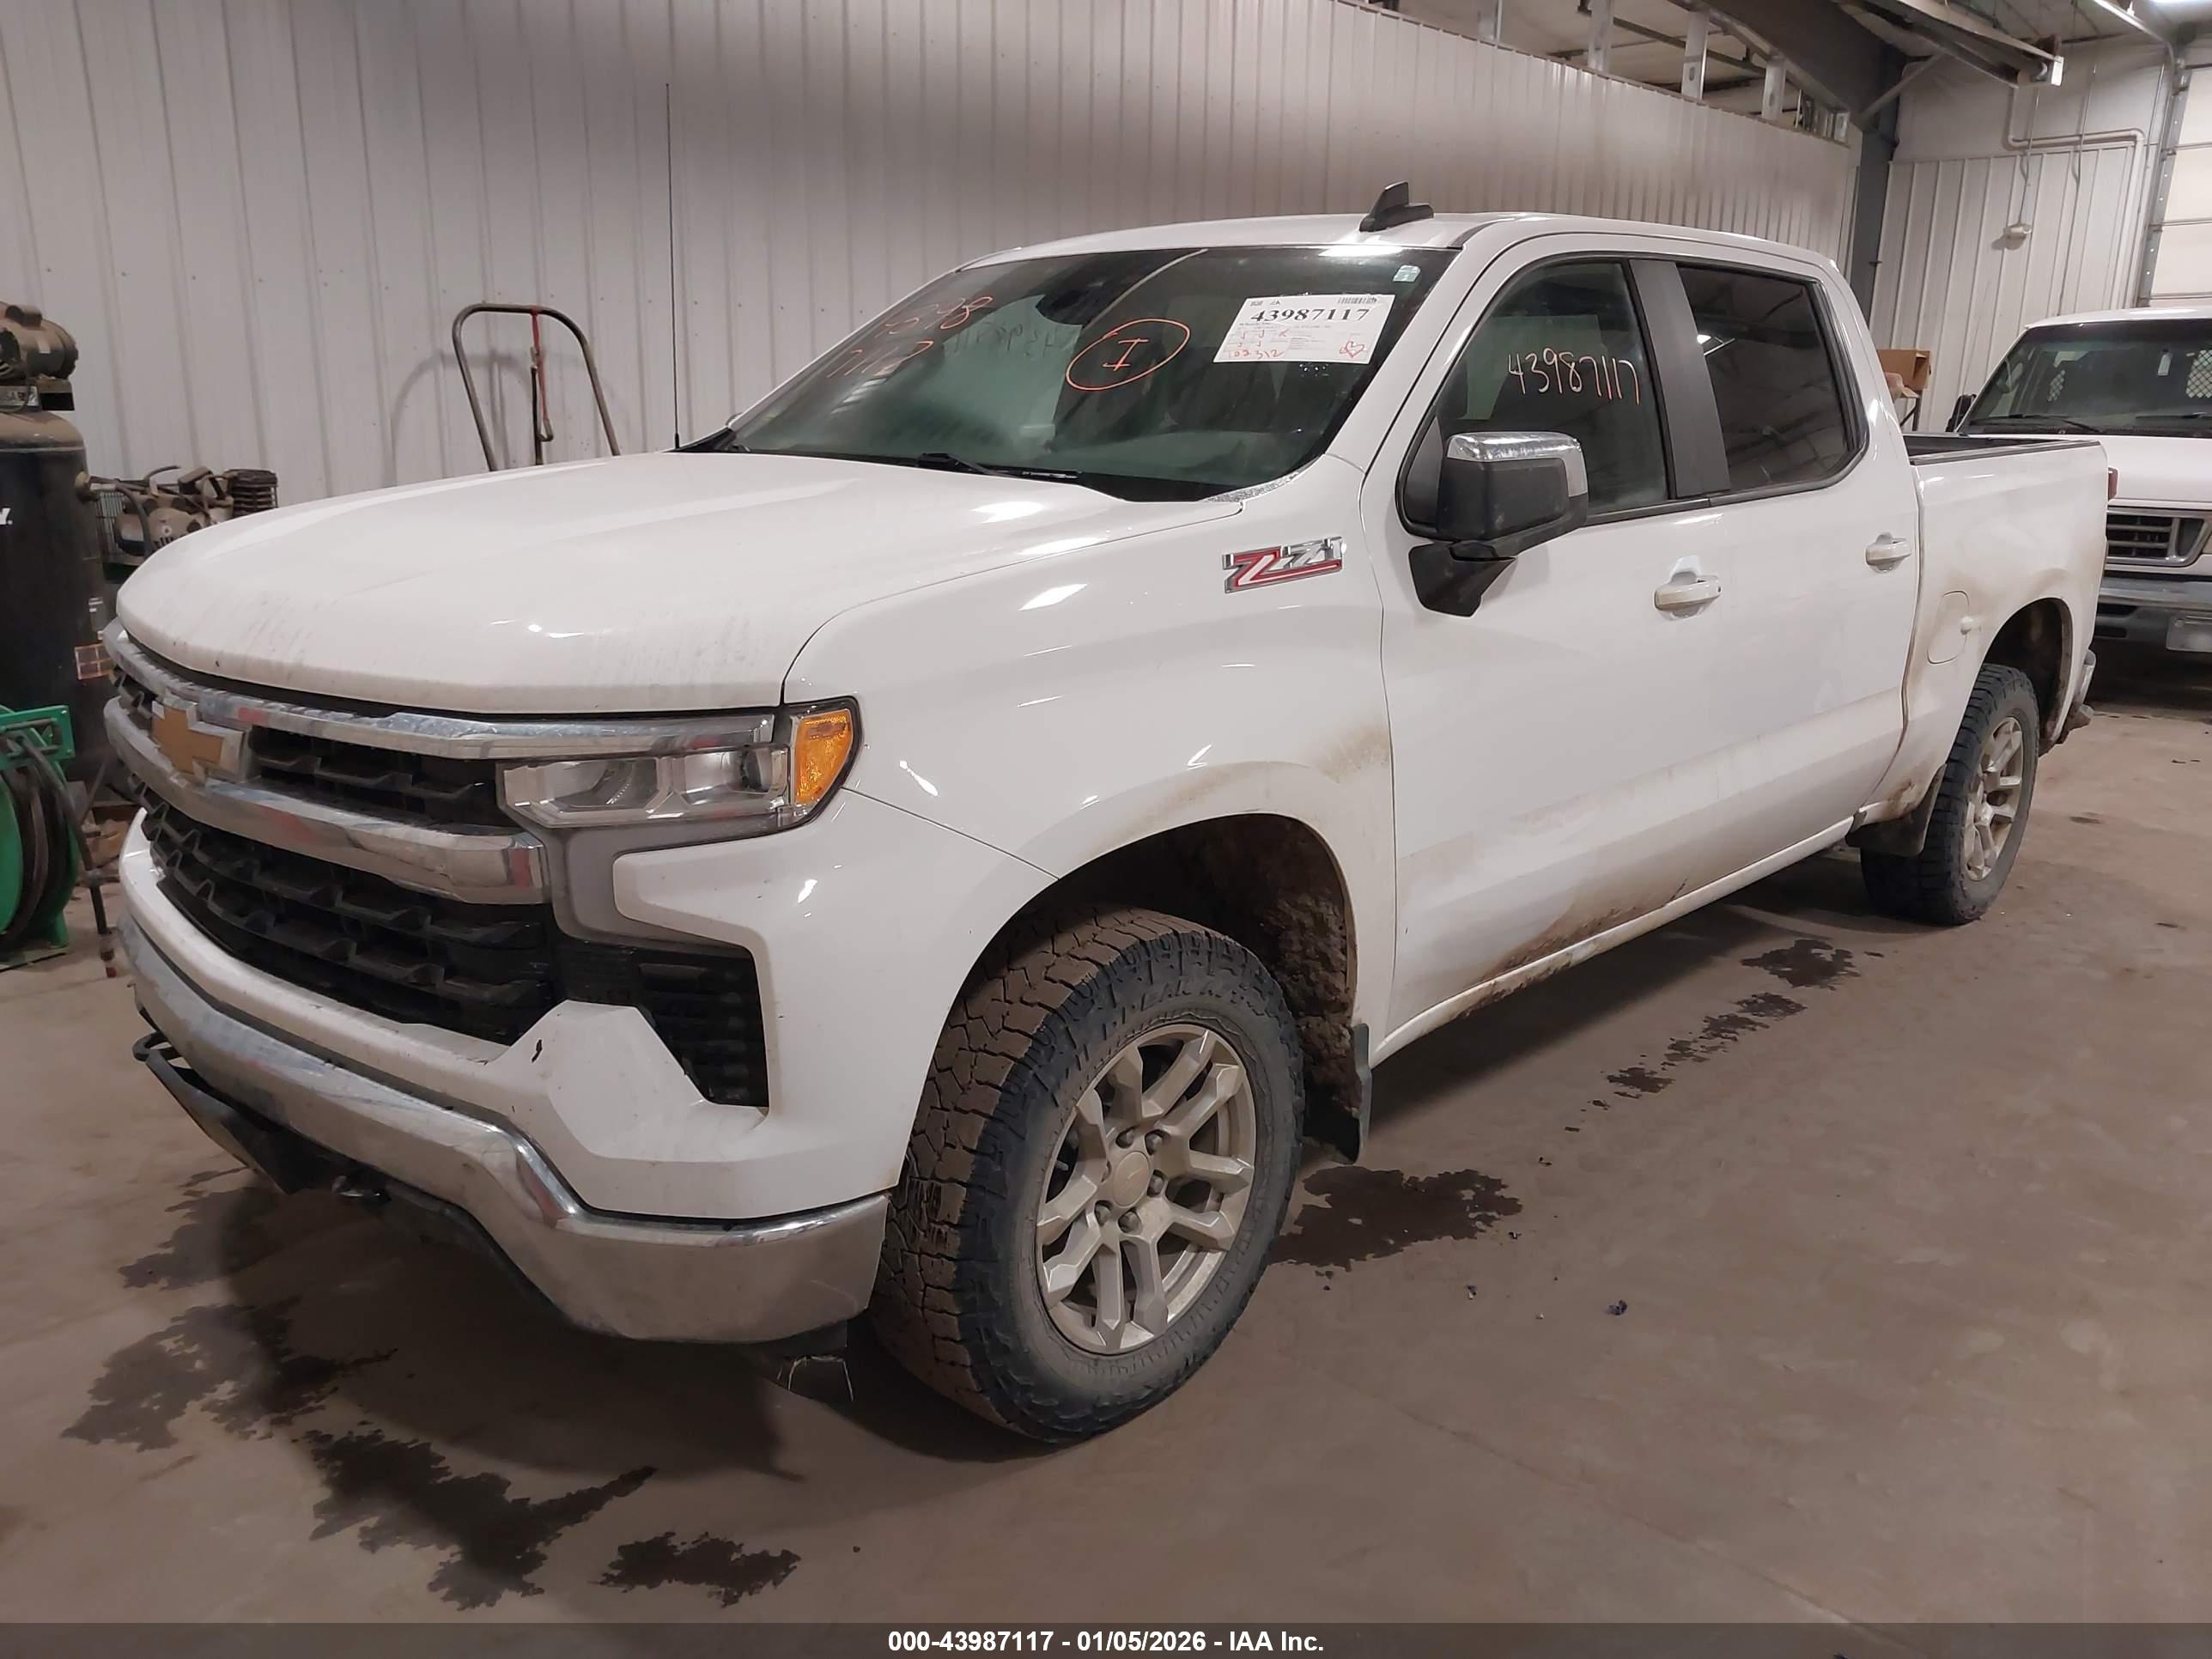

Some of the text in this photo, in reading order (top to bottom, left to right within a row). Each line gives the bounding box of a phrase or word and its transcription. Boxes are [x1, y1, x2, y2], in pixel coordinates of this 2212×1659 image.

[1249, 308, 1370, 322] 43987117
[1507, 347, 1641, 406] 43987117
[1221, 536, 1344, 594] Z71
